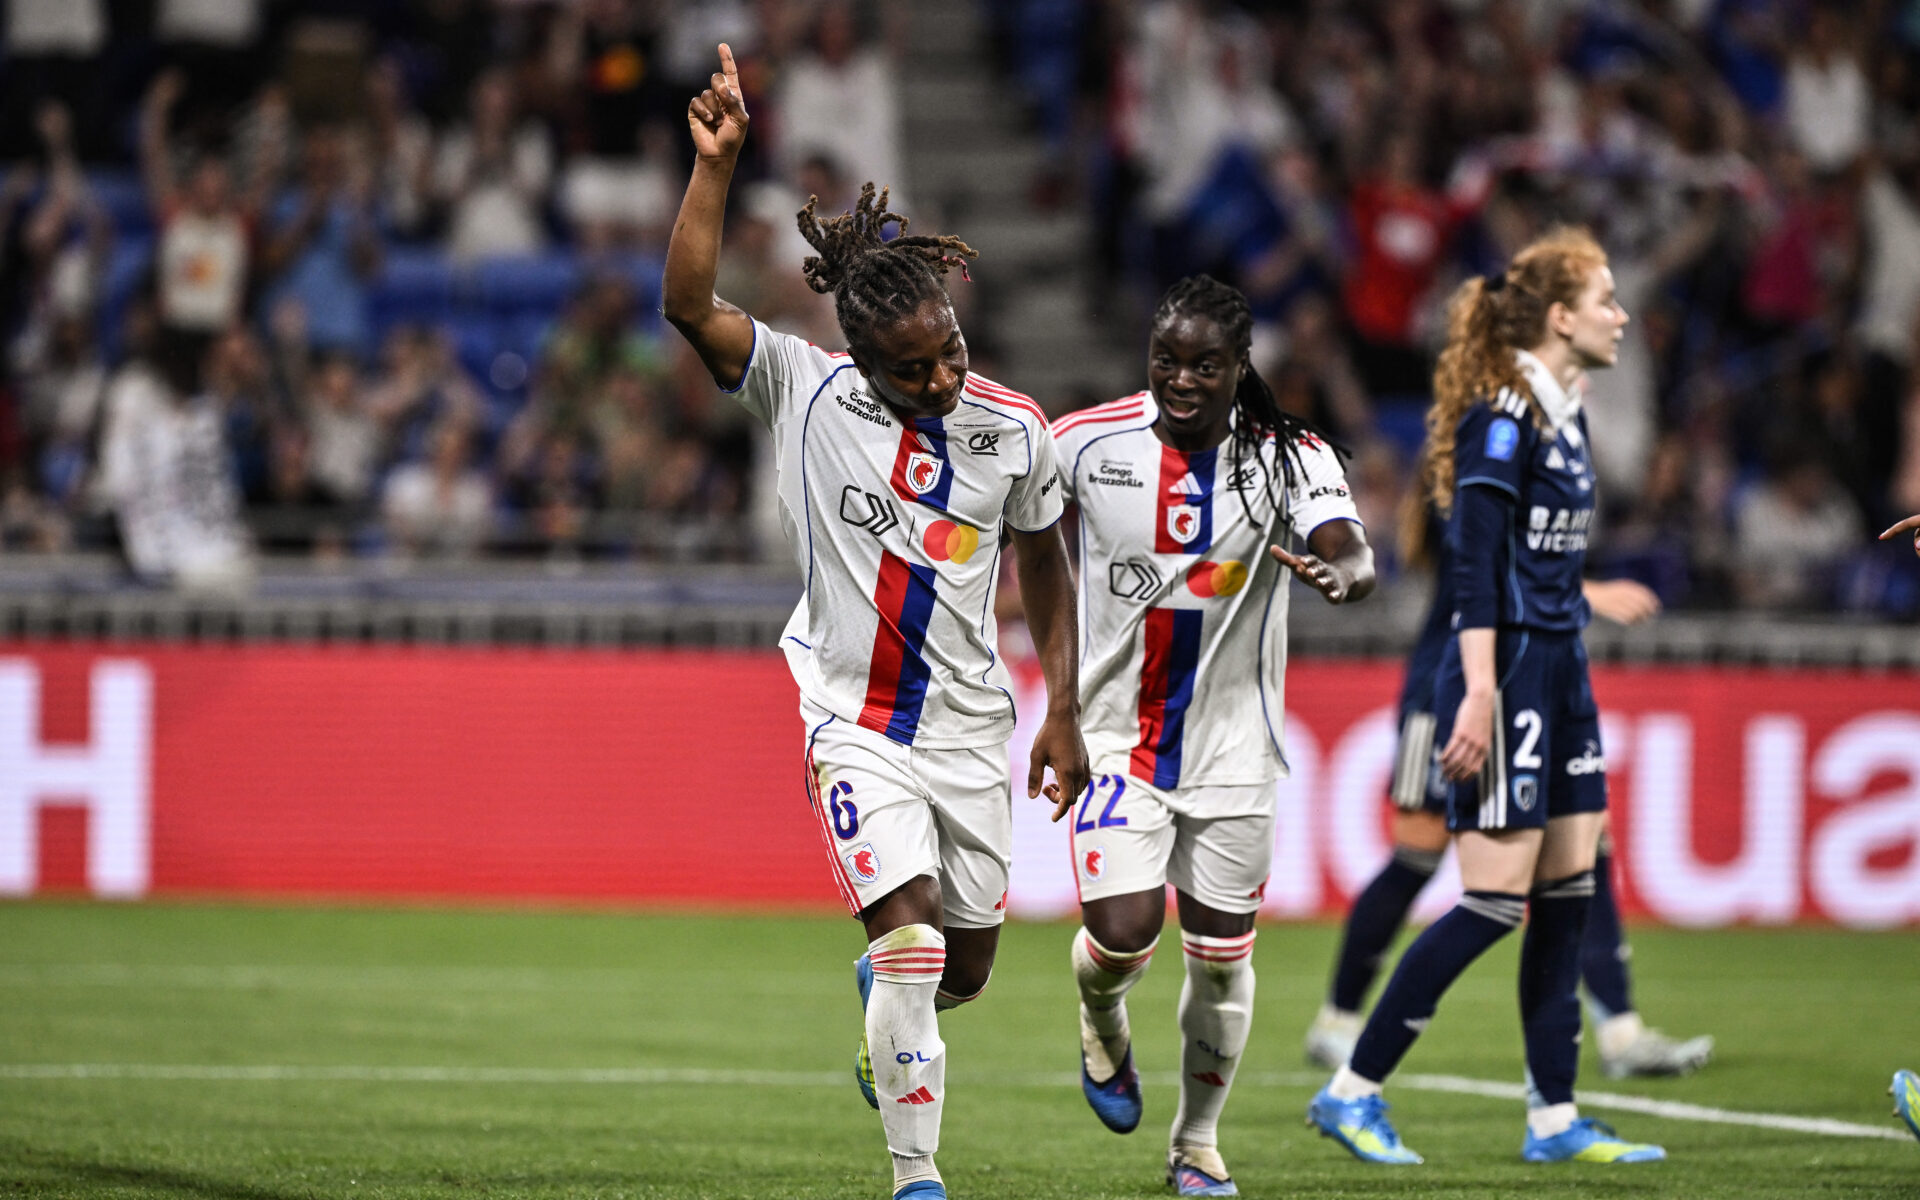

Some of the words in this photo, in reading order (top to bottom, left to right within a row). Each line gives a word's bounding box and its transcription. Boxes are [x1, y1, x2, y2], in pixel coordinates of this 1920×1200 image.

[849, 392, 882, 413] Congo
[1088, 473, 1145, 488] Brazzaville
[1100, 464, 1133, 479] Congo
[1512, 709, 1543, 769] 2
[0, 657, 153, 898] H
[830, 780, 859, 840] 6
[1076, 774, 1128, 834] 22
[896, 1050, 931, 1065] OL
